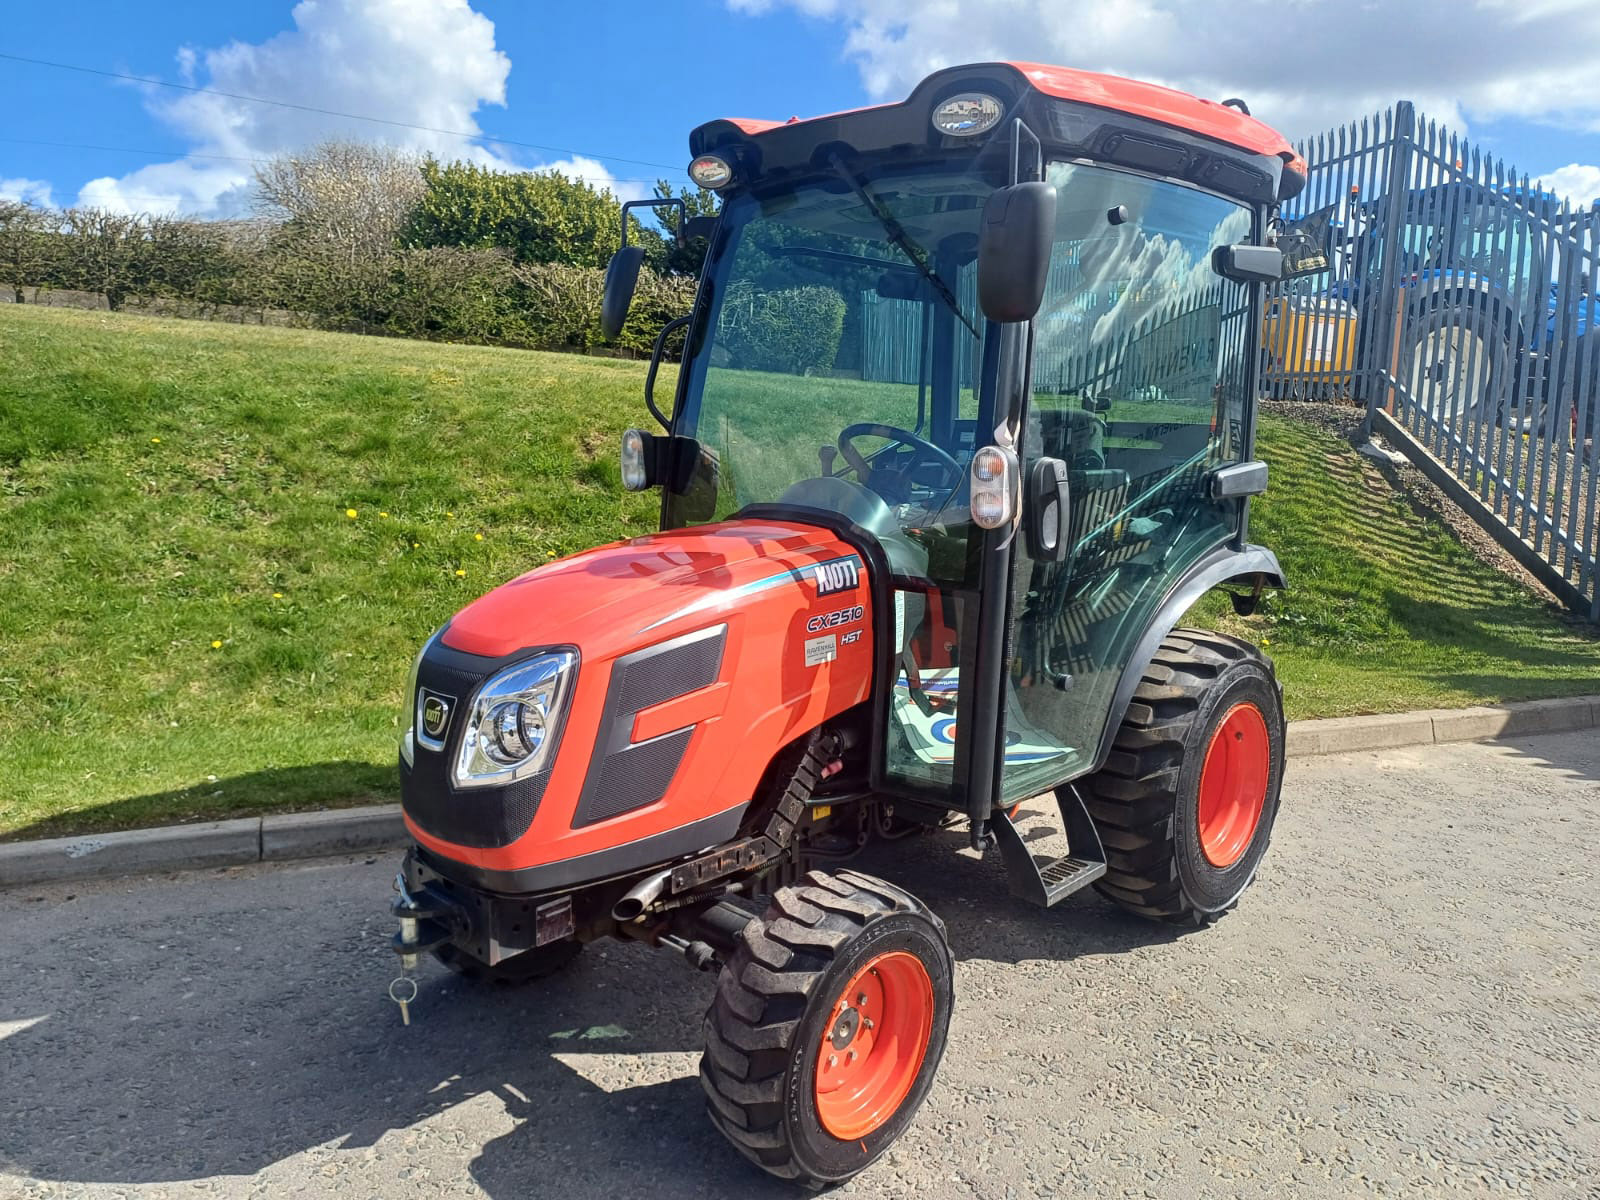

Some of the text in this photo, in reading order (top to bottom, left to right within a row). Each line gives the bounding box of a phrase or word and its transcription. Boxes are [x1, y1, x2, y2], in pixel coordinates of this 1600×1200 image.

[815, 560, 858, 593] KIOTI
[807, 605, 864, 632] CX2510
[841, 630, 862, 646] HST
